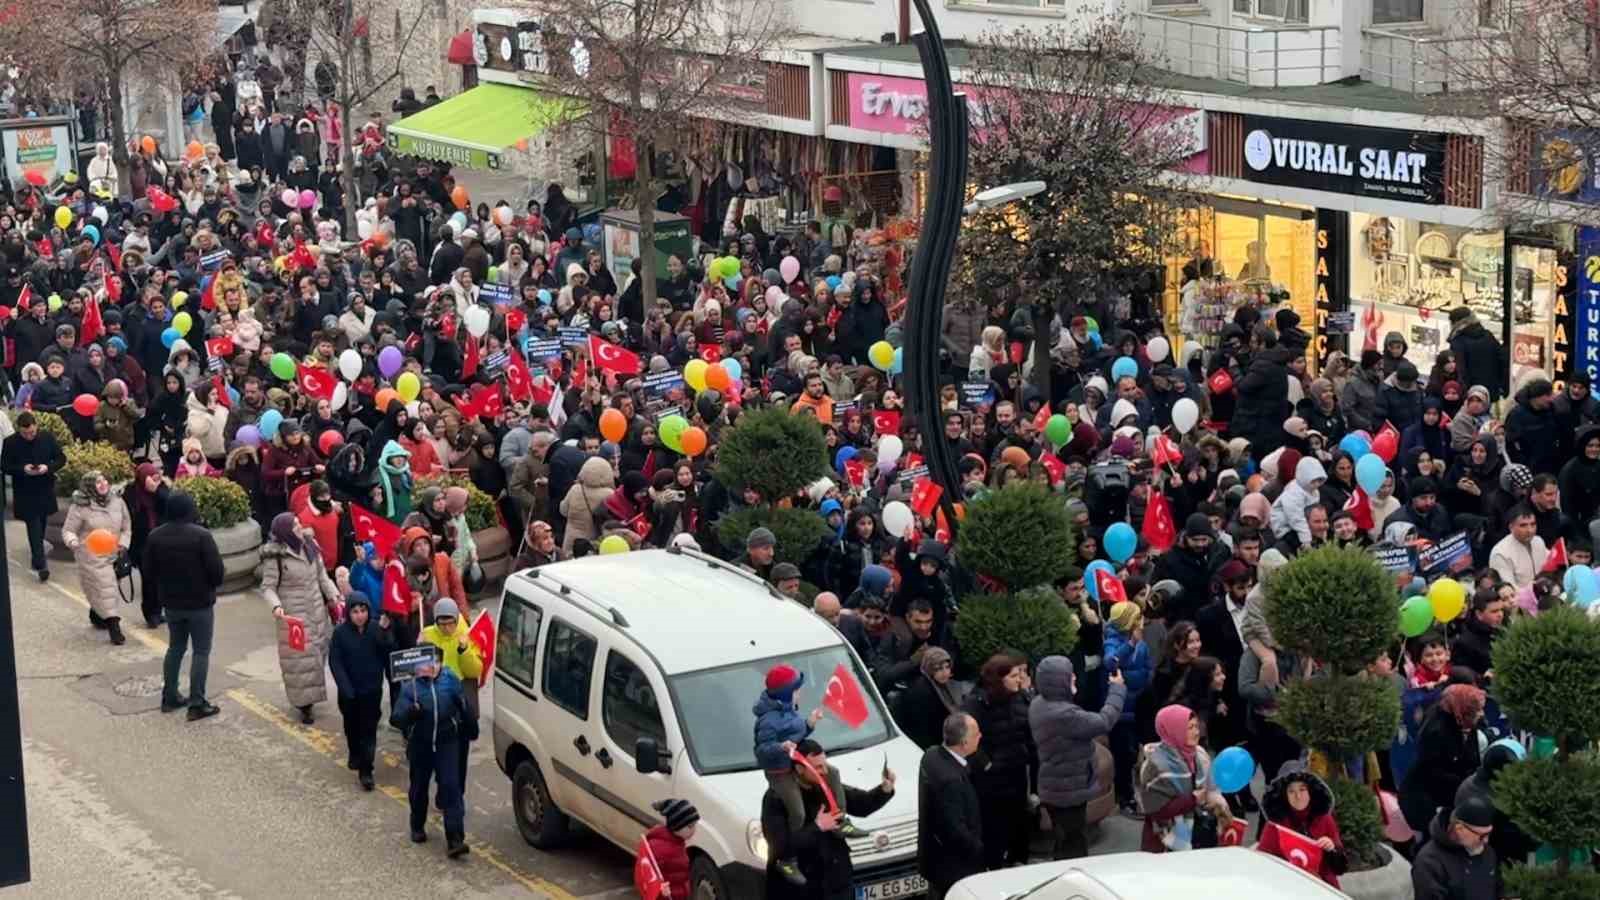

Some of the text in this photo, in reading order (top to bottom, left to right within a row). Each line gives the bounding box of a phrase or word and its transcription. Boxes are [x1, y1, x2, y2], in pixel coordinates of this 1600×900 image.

[1272, 138, 1427, 184] VURAL SAAT
[864, 886, 877, 900] 14
[882, 880, 900, 897] EG
